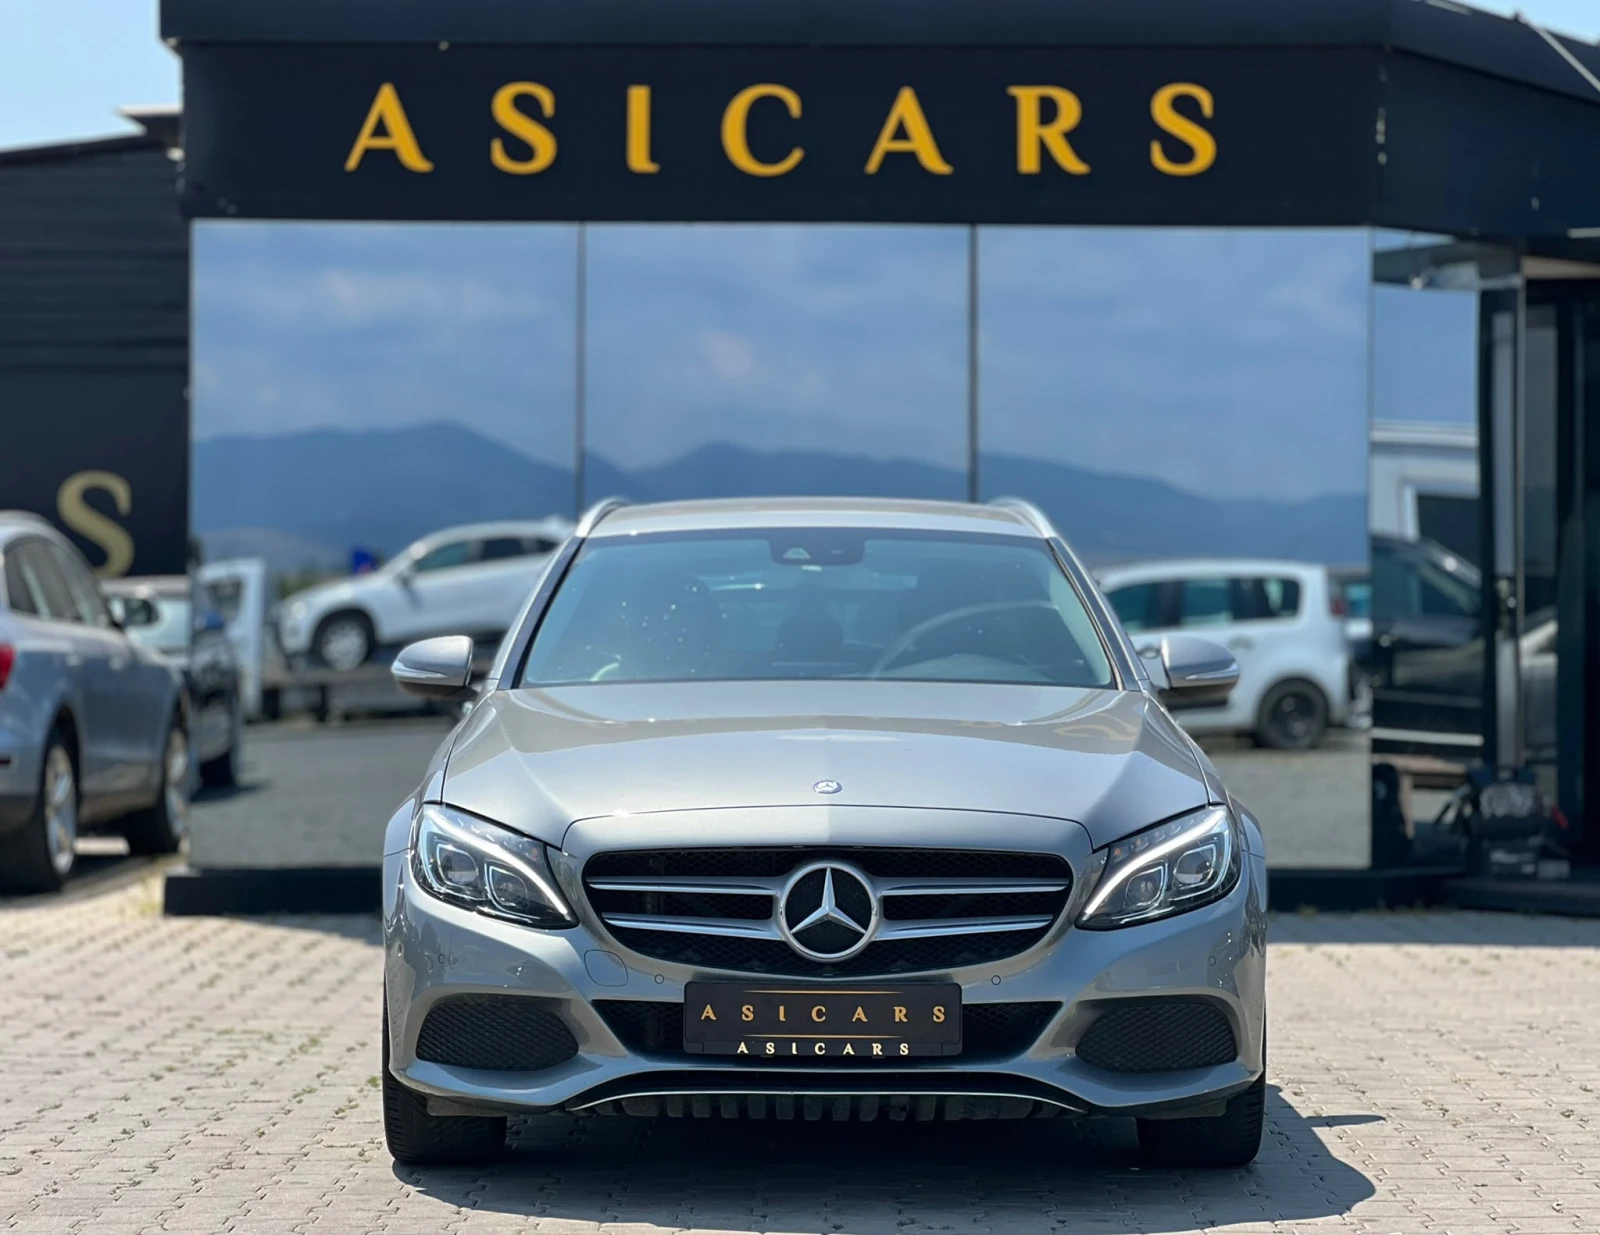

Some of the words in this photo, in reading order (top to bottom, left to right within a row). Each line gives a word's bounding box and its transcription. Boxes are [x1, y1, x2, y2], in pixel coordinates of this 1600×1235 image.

[345, 82, 1218, 176] ASICARS
[57, 471, 134, 577] S
[701, 1004, 946, 1023] ASICARS
[737, 1041, 910, 1056] ASICARS
